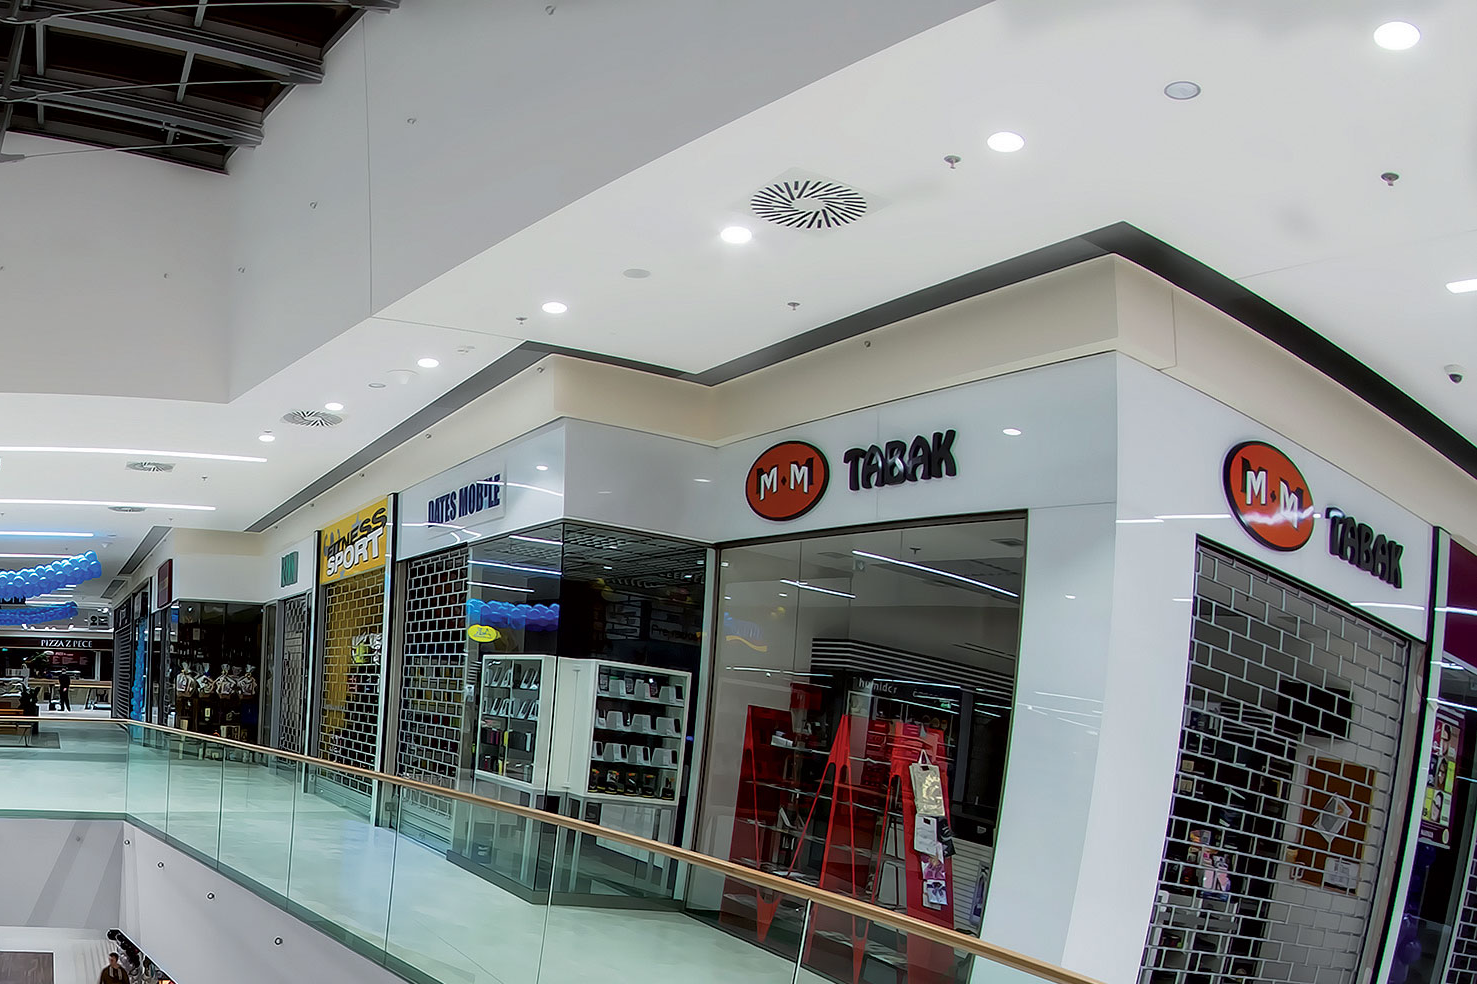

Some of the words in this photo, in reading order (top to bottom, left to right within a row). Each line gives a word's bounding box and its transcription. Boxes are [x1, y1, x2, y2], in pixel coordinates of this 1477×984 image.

[843, 429, 957, 491] TABAK
[326, 527, 384, 577] SPORT
[327, 507, 387, 557] FITNESS
[1325, 507, 1404, 589] TABAK
[40, 639, 65, 648] PIZZA
[65, 640, 72, 648] Z
[73, 640, 93, 648] PECE
